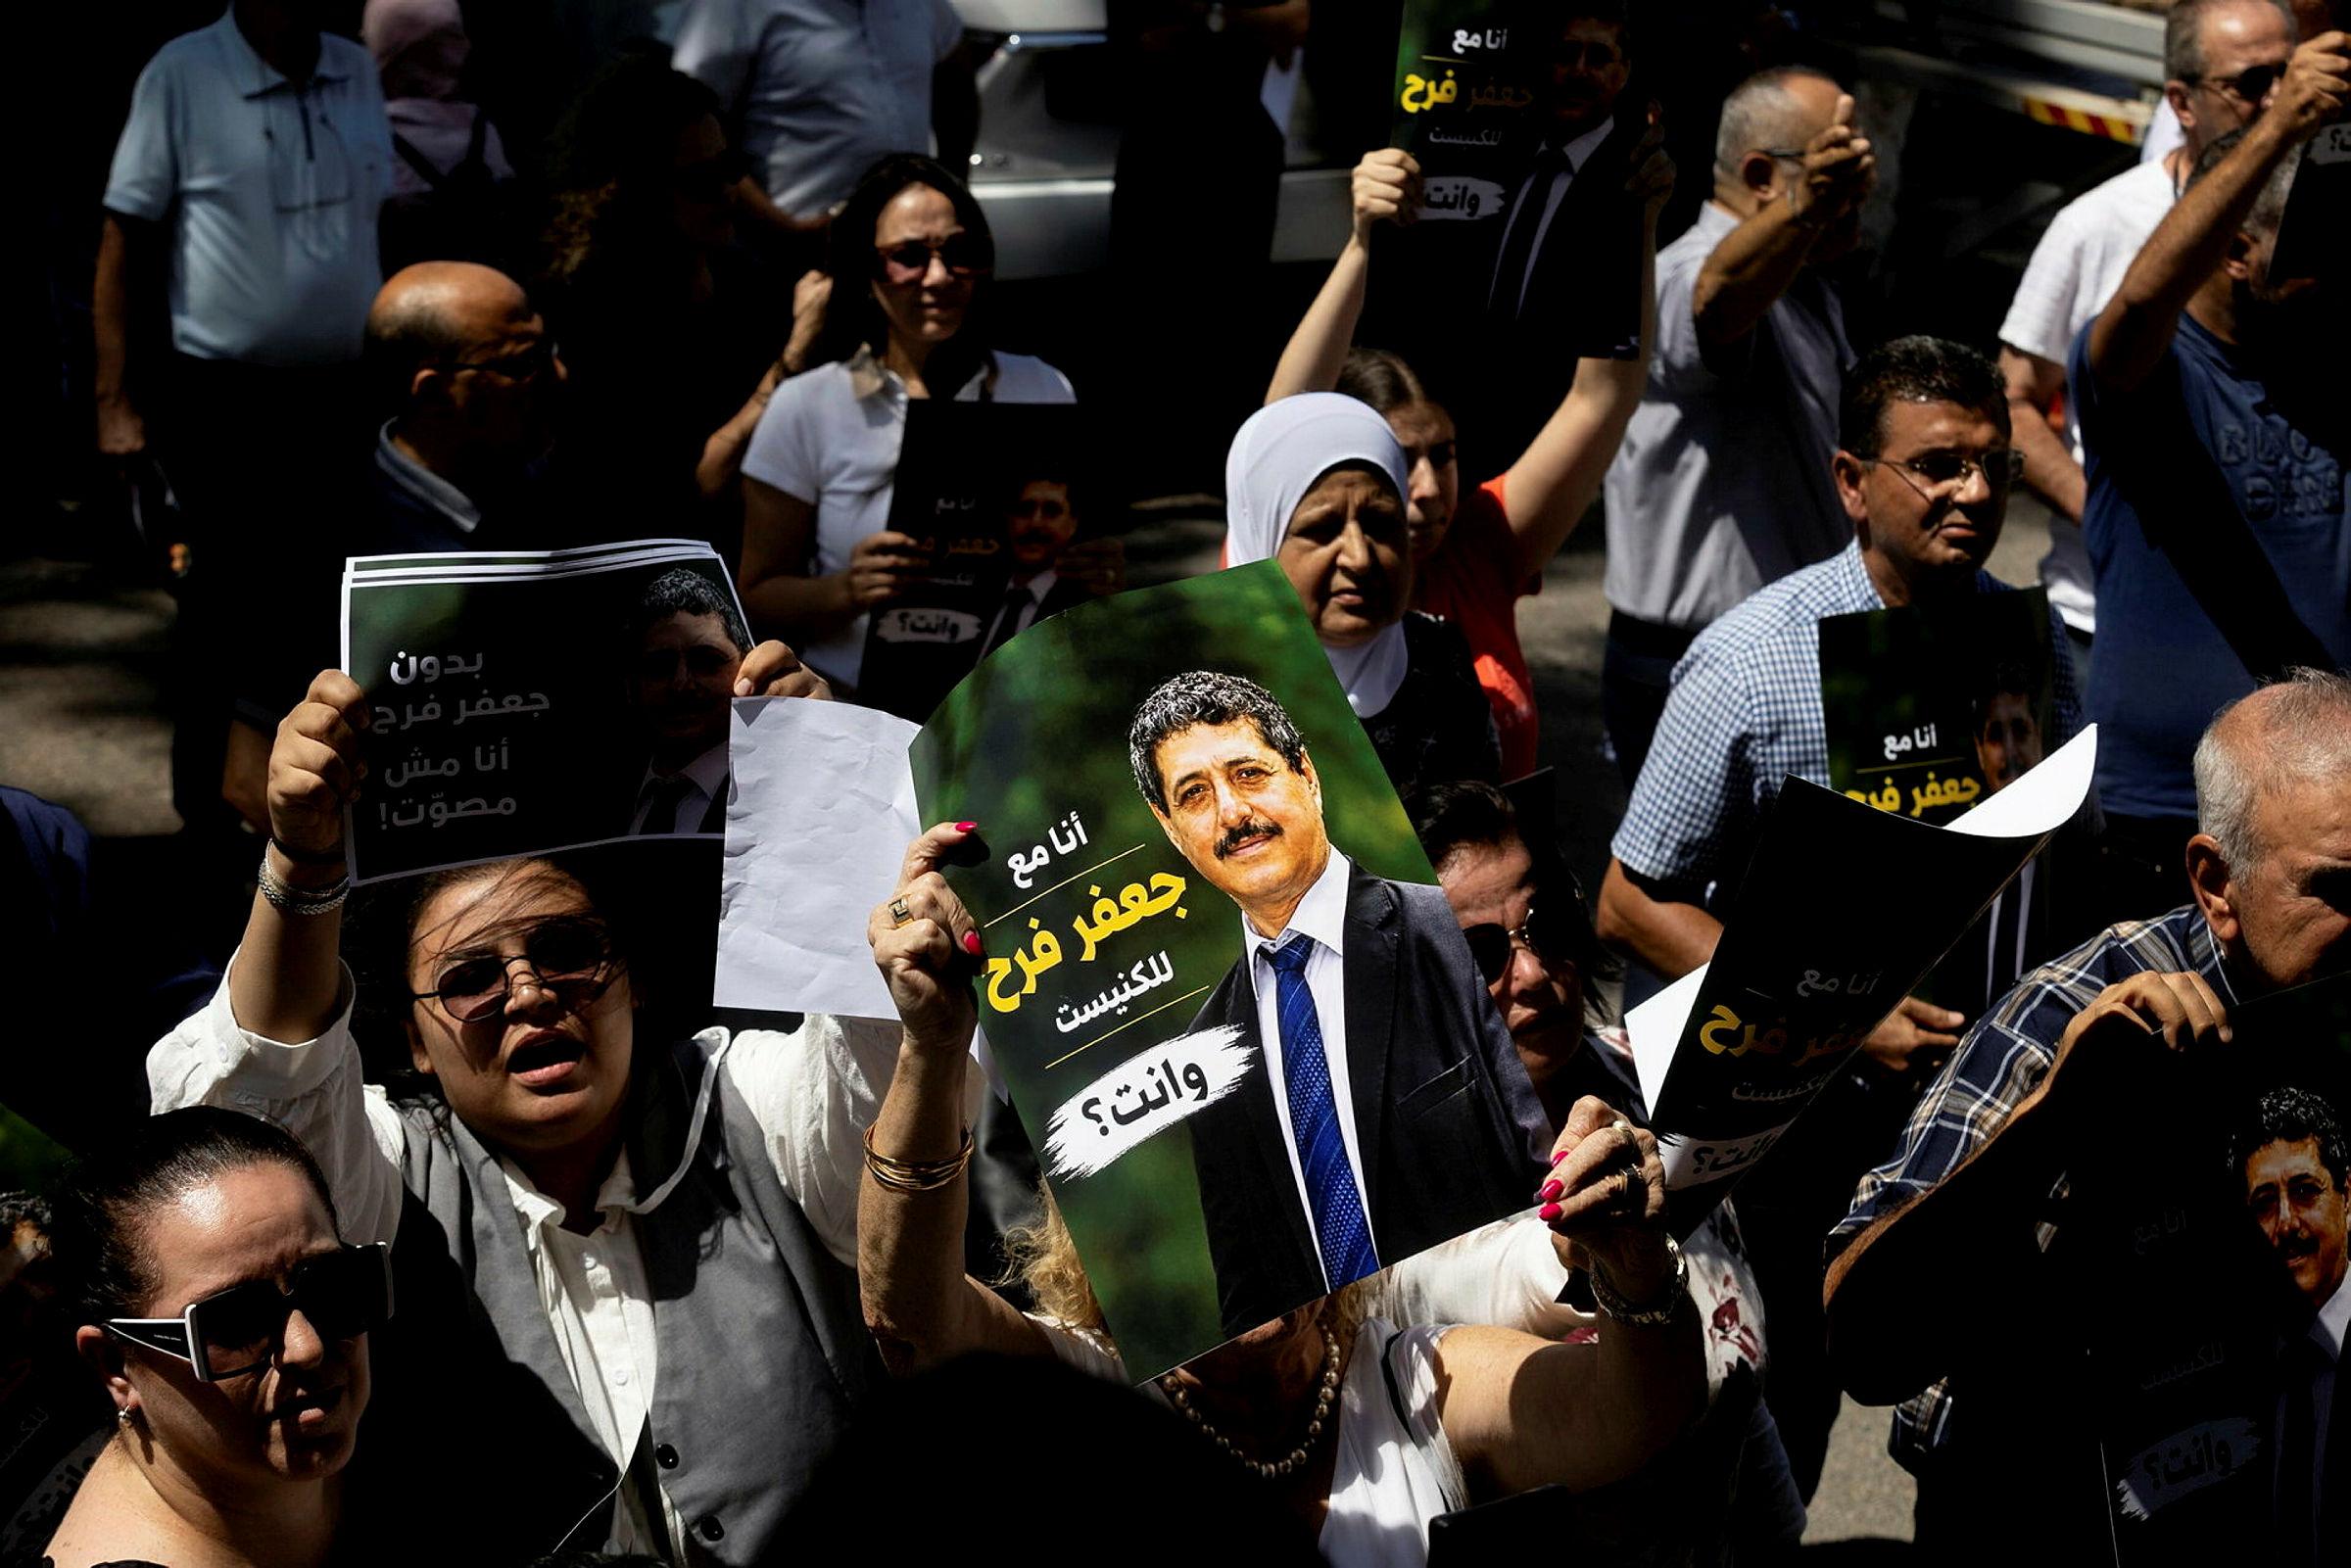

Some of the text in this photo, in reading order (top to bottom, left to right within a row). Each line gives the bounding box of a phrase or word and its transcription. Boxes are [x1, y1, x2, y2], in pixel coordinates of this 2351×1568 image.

[1451, 28, 1483, 55] مع
[1401, 69, 1458, 114] فرح
[1425, 184, 1481, 217] وانت
[390, 650, 484, 686] بدون
[371, 688, 551, 734] جعفر فرح
[385, 736, 509, 788] أنا مش
[1883, 734, 1911, 761] مع
[1910, 771, 1982, 818] جعفر
[1007, 811, 1089, 889] أنا مع
[986, 871, 1188, 1013] جعفر فرح
[1055, 950, 1175, 1033] للكنيست
[1797, 969, 1840, 997] مع
[1700, 1005, 1786, 1058] فرح
[1081, 1059, 1209, 1136] وانت؟
